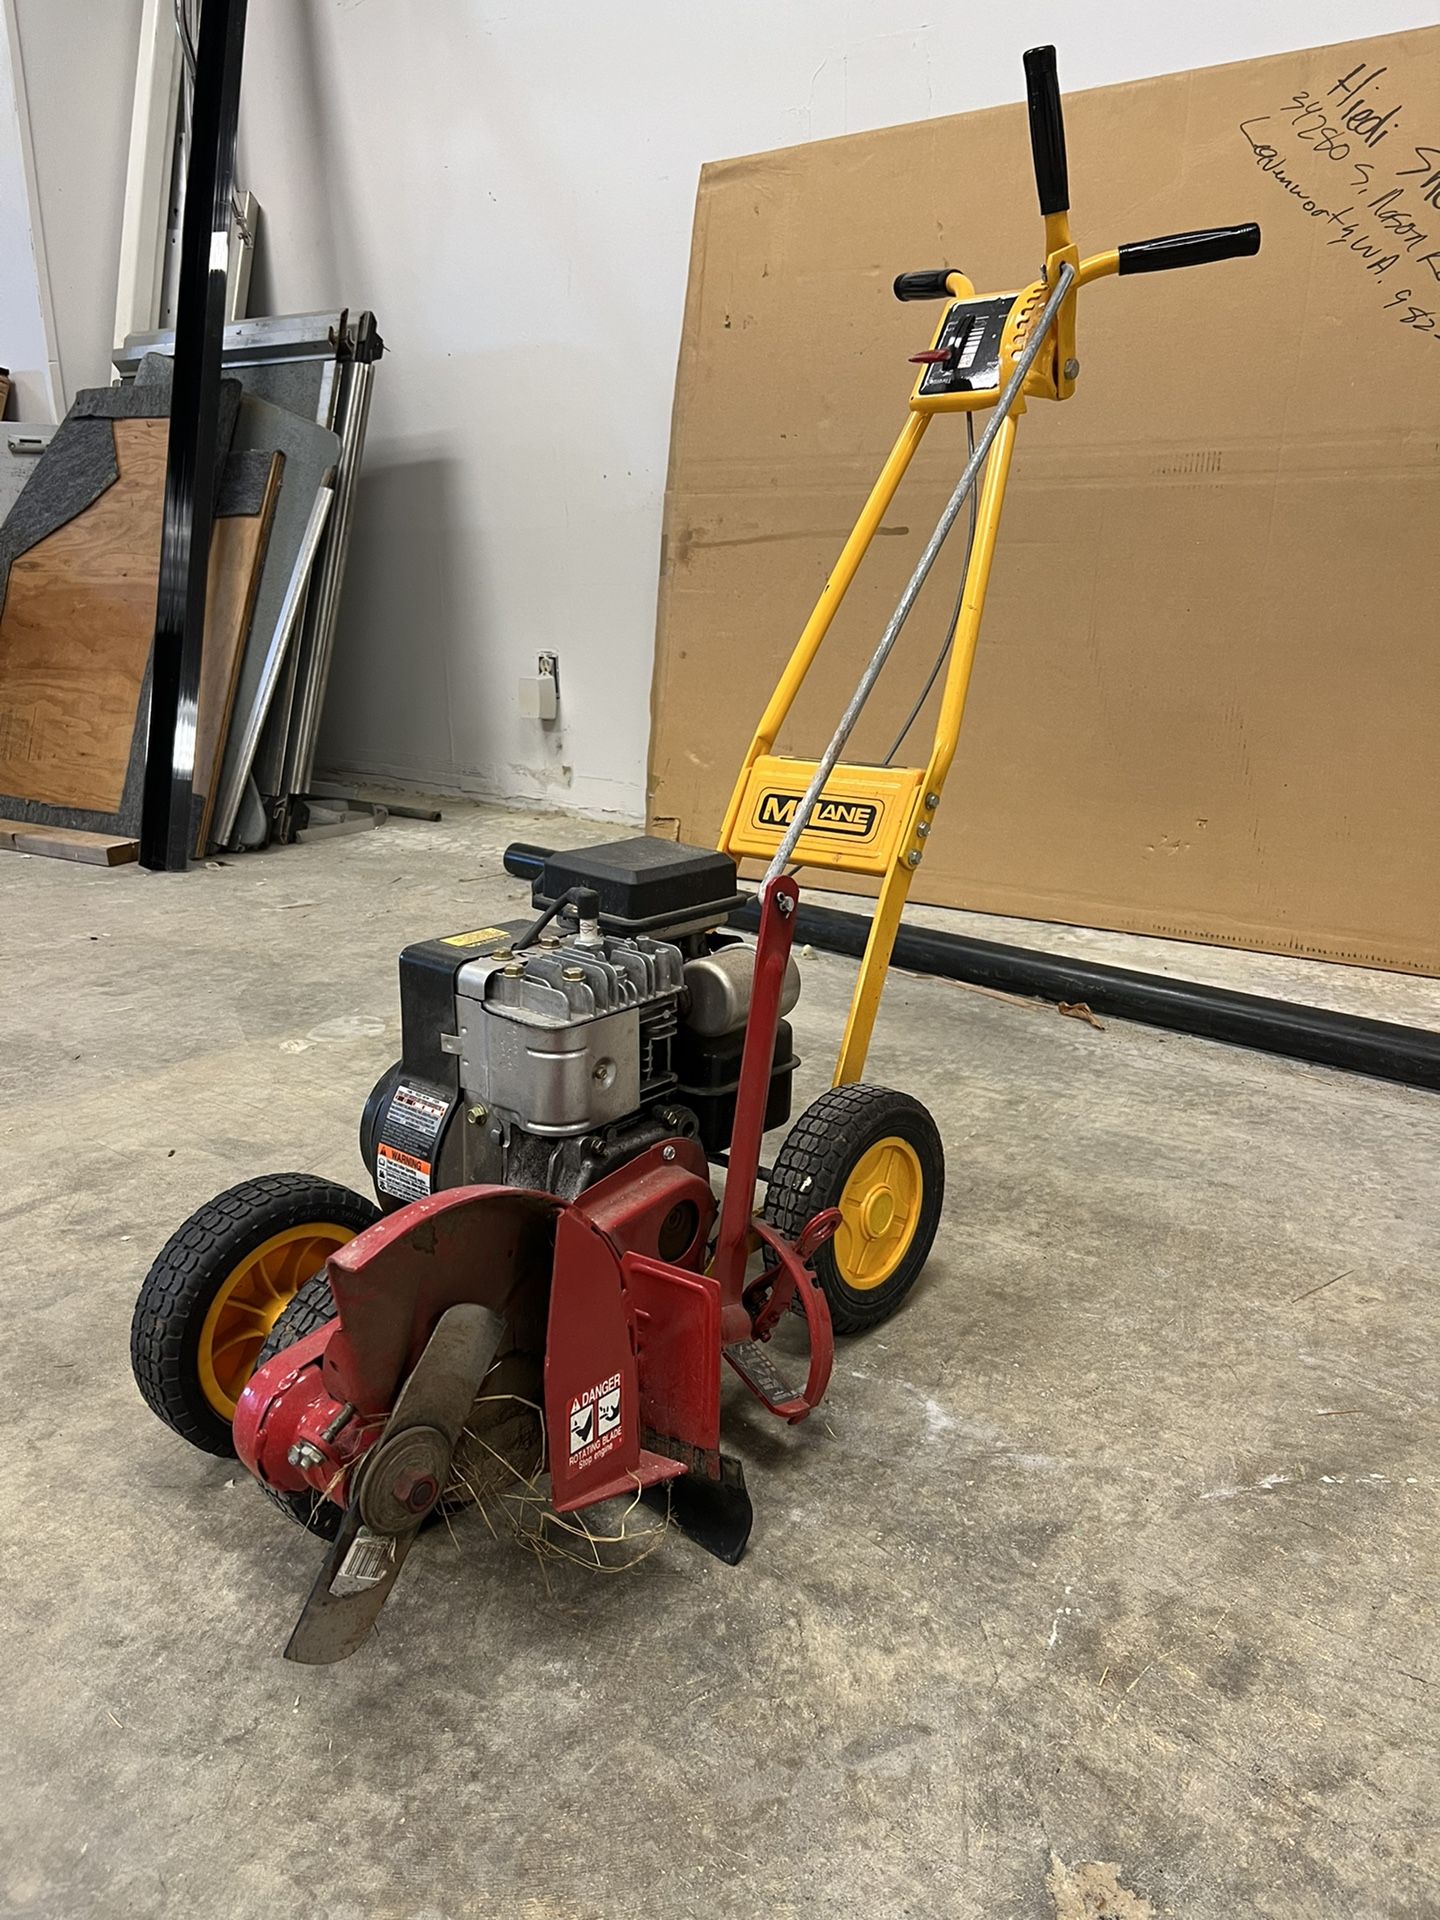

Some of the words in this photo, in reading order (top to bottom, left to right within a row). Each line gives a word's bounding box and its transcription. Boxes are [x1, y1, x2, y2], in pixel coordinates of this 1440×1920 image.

[1327, 63, 1403, 148] Hiedi
[1279, 90, 1351, 161] 34280
[762, 797, 872, 833] MLANE
[391, 1150, 422, 1171] WARNING
[582, 1373, 621, 1407] DANGER
[569, 1440, 601, 1466] ROTATING
[602, 1426, 622, 1446] BLADE
